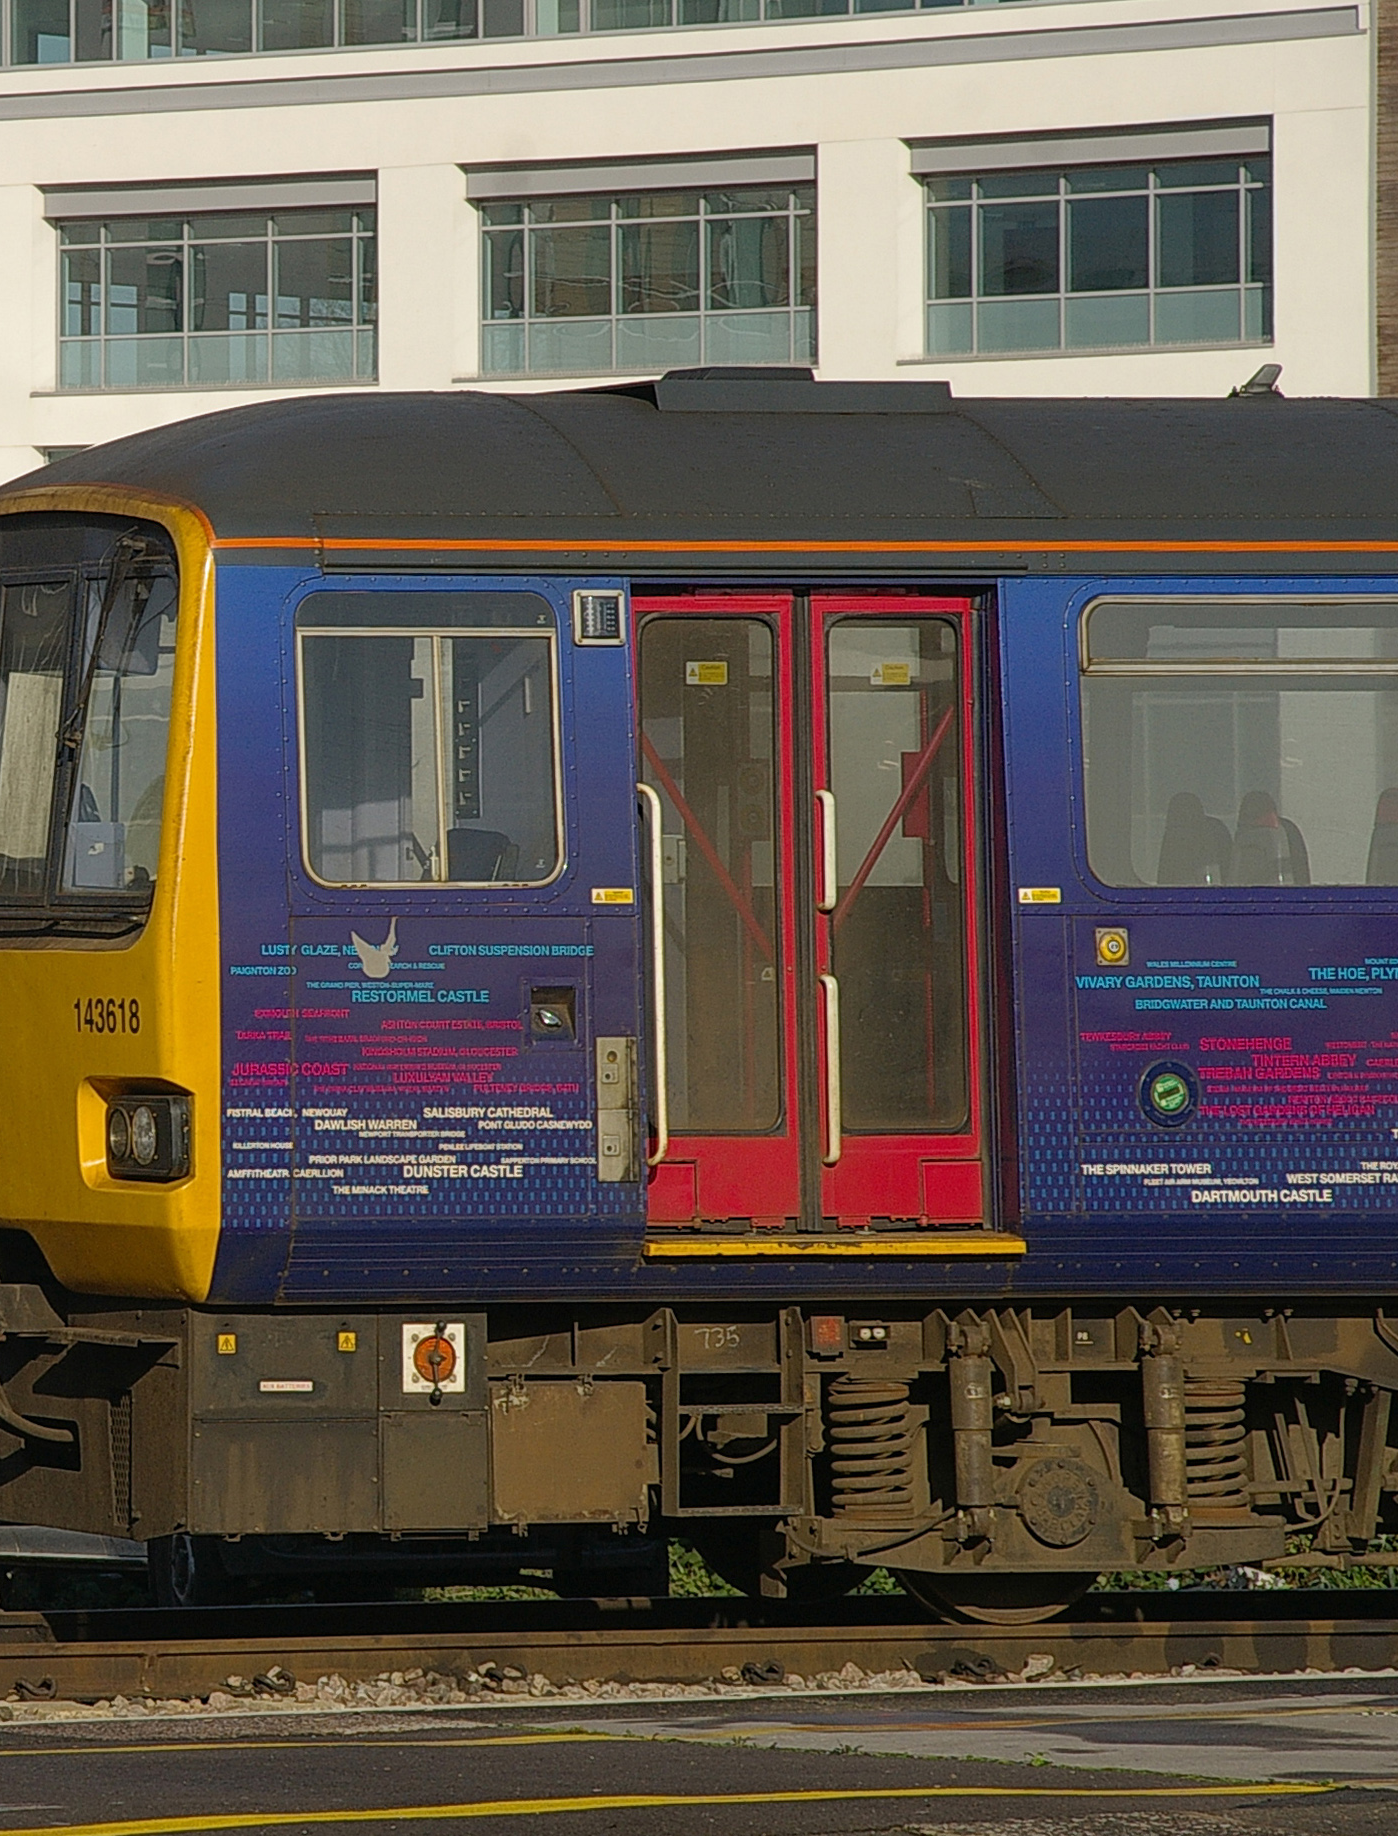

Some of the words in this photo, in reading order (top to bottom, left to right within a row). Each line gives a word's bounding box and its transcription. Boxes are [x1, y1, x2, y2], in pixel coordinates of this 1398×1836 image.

[261, 945, 297, 955] LUSTY
[302, 945, 341, 956] GLAZE,
[429, 945, 476, 955] CLIFTON
[478, 945, 549, 955] SUSPENSION
[551, 945, 594, 956] BRIDGE
[230, 966, 276, 975] PAIGNTON
[277, 966, 297, 975] ZOO
[1308, 967, 1336, 980] THE
[1337, 967, 1370, 981] HOE,
[1076, 976, 1123, 988] VIVARY
[1125, 976, 1195, 990] GARDENS,
[1196, 975, 1259, 988] TAUNTON
[352, 990, 435, 1002] RESTORMEL
[437, 990, 489, 1002] CASTLE
[1135, 999, 1209, 1010] BRIDGWATER
[1210, 999, 1234, 1009] AND
[1235, 999, 1288, 1009] TAUNTON
[1289, 998, 1327, 1009] CANAL
[74, 998, 140, 1033] 143618
[1199, 1037, 1292, 1051] STONEHENGE
[1251, 1054, 1309, 1067] TINTERN
[1312, 1053, 1357, 1066] ABBEY
[232, 1062, 299, 1076] JURASSIC
[302, 1062, 349, 1076] COAST
[1198, 1066, 1252, 1080] TREBAH
[1255, 1066, 1321, 1079] GARDENS
[393, 1072, 451, 1083] LUXULYAN
[452, 1072, 494, 1083] VALLEY
[227, 1108, 263, 1117] FISTRAL
[302, 1108, 348, 1117] NEWQUAY
[423, 1107, 486, 1118] SALISBURY
[487, 1107, 554, 1118] CATHEDRAL
[1198, 1105, 1222, 1116] THE
[1223, 1105, 1252, 1116] LOST
[1253, 1104, 1307, 1115] GARDENS
[1309, 1104, 1325, 1115] OF
[1326, 1104, 1375, 1115] HELIGAN
[315, 1120, 366, 1130] DAWLISH
[367, 1120, 417, 1130] WARREN
[478, 1121, 502, 1130] PONT
[536, 1121, 593, 1130] CASNEWYDD
[309, 1155, 338, 1164] PRIOR
[339, 1155, 364, 1164] PARK
[364, 1155, 417, 1164] LANDSCAPE
[418, 1155, 456, 1164] GARDEN
[1360, 1161, 1379, 1170] THE
[293, 1169, 344, 1178] CAERLLION
[403, 1165, 468, 1178] DUNSTER
[470, 1165, 523, 1178] CASTLE
[1081, 1163, 1104, 1175] THE
[1105, 1163, 1168, 1175] SPINNAKER
[1169, 1163, 1212, 1174] TOWER
[1286, 1173, 1319, 1184] WEST
[1319, 1172, 1381, 1184] SOMERSET
[332, 1185, 351, 1194] THE
[352, 1185, 388, 1194] MINACK
[389, 1185, 429, 1194] THEATRE
[1191, 1189, 1278, 1203] DARTMOUTH
[1279, 1189, 1333, 1202] CASTLE
[694, 1325, 740, 1349] 735
